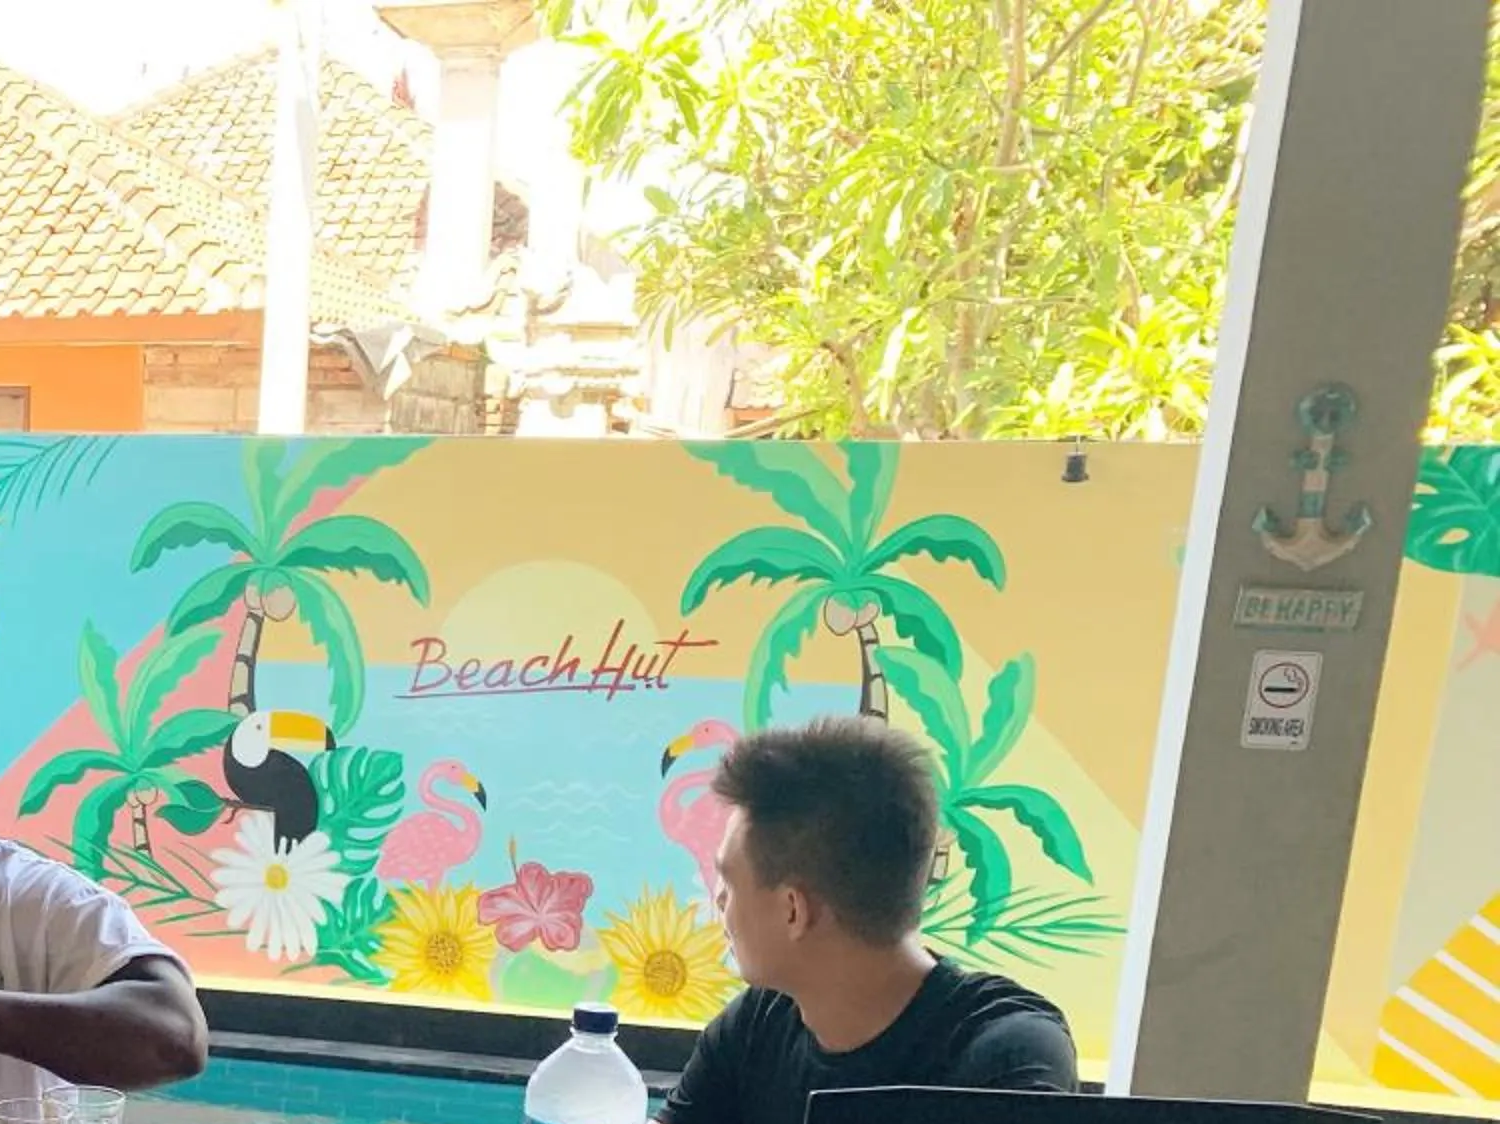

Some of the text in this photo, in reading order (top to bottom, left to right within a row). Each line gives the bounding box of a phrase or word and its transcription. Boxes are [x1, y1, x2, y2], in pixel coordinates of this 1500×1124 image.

[1274, 597, 1354, 623] HAPPY
[409, 618, 719, 701] Beach Hut
